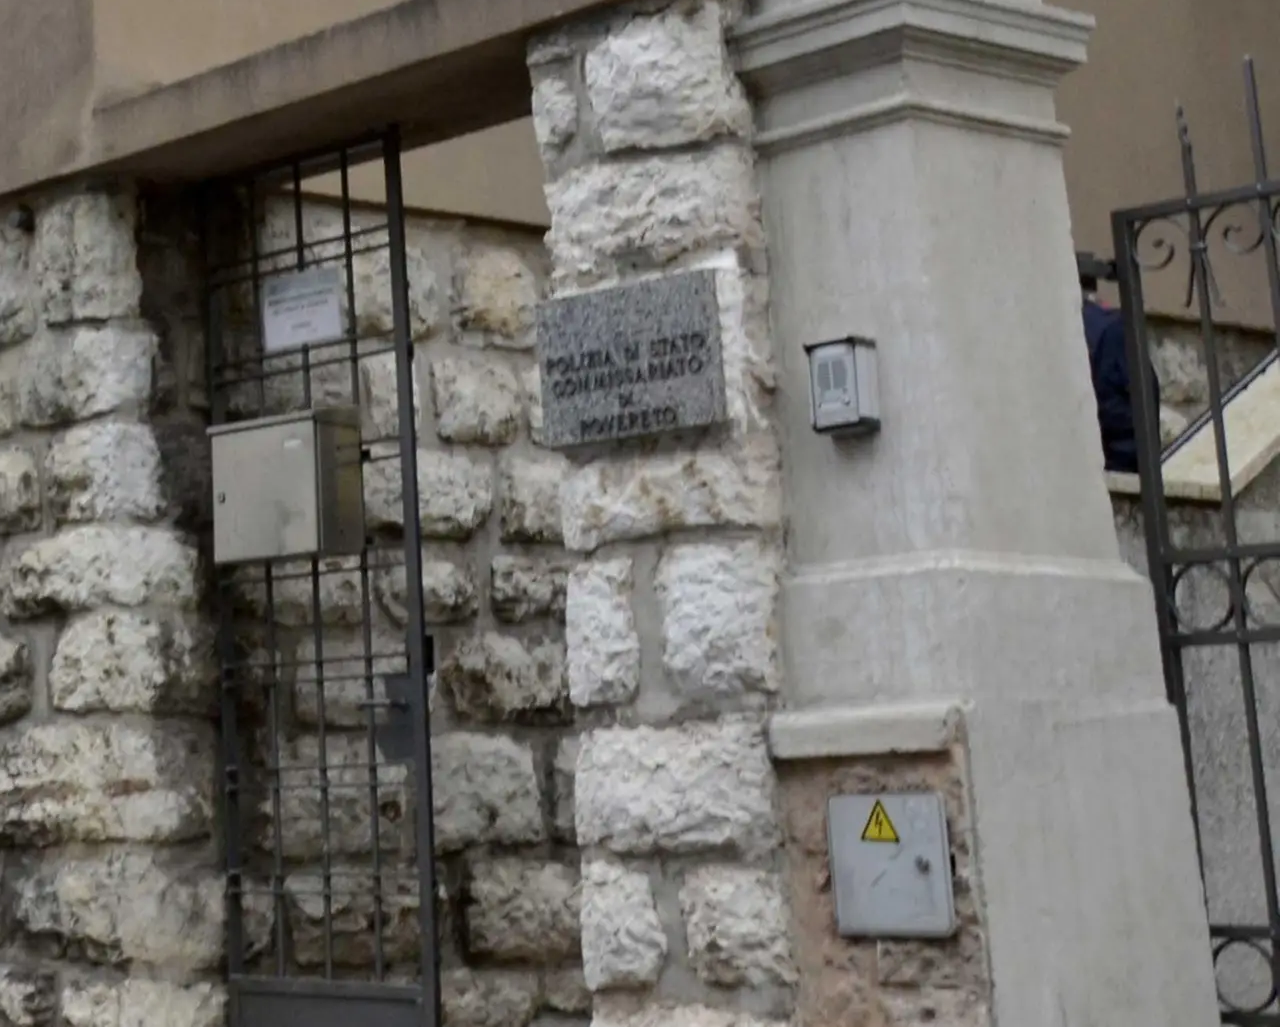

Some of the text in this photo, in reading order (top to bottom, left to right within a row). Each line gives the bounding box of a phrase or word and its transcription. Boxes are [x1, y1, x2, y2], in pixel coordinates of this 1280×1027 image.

[546, 350, 615, 376] POLIZIA
[650, 330, 706, 358] STATO
[552, 355, 703, 398] COMMISSARIATO
[580, 405, 676, 438] ROVERETO
